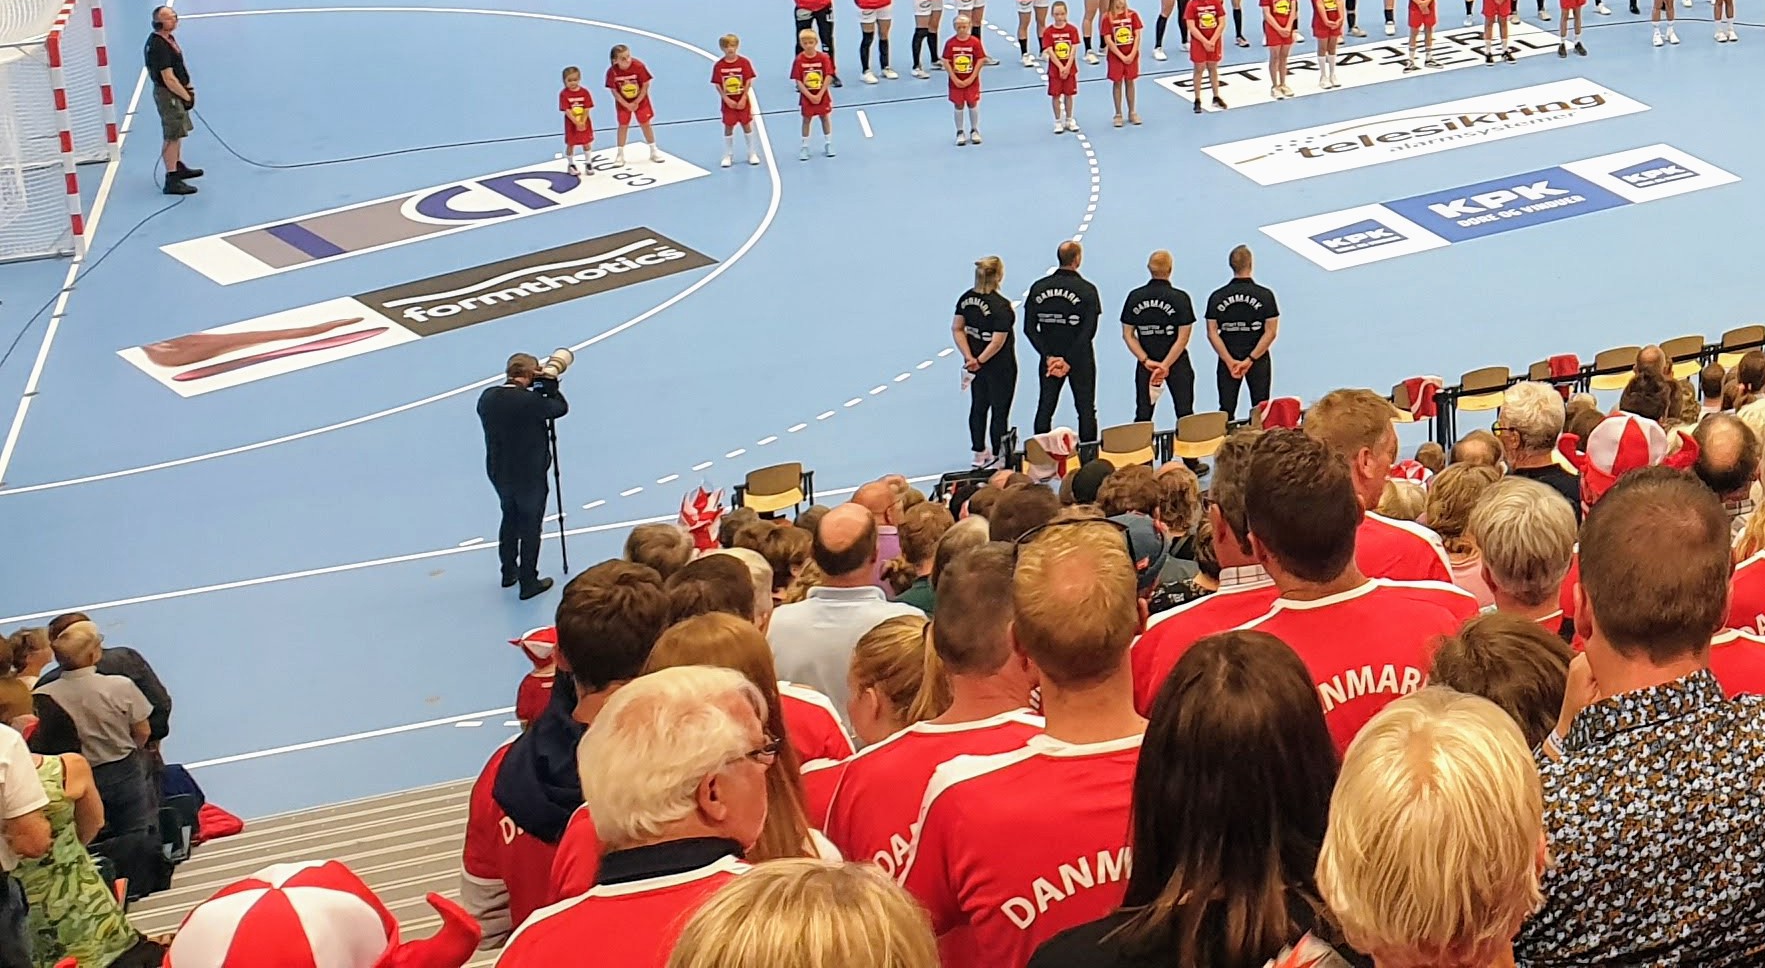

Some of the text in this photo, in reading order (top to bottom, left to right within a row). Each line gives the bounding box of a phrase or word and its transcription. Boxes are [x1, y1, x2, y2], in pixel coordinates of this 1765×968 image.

[1295, 92, 1606, 159] telesikring
[1389, 111, 1577, 153] alarmsystemer
[1621, 164, 1687, 183] KPK
[1428, 180, 1570, 219] KPK
[1500, 209, 1523, 219] OG
[1520, 194, 1587, 213] VINDUER
[1321, 227, 1394, 248] KPK
[402, 245, 688, 323] formthotics
[1035, 288, 1081, 305] DANMARK
[1132, 299, 1176, 316] DANMARK
[1217, 294, 1263, 312] DANMARK
[1318, 664, 1425, 713] NMAR
[1000, 846, 1133, 930] DANM
